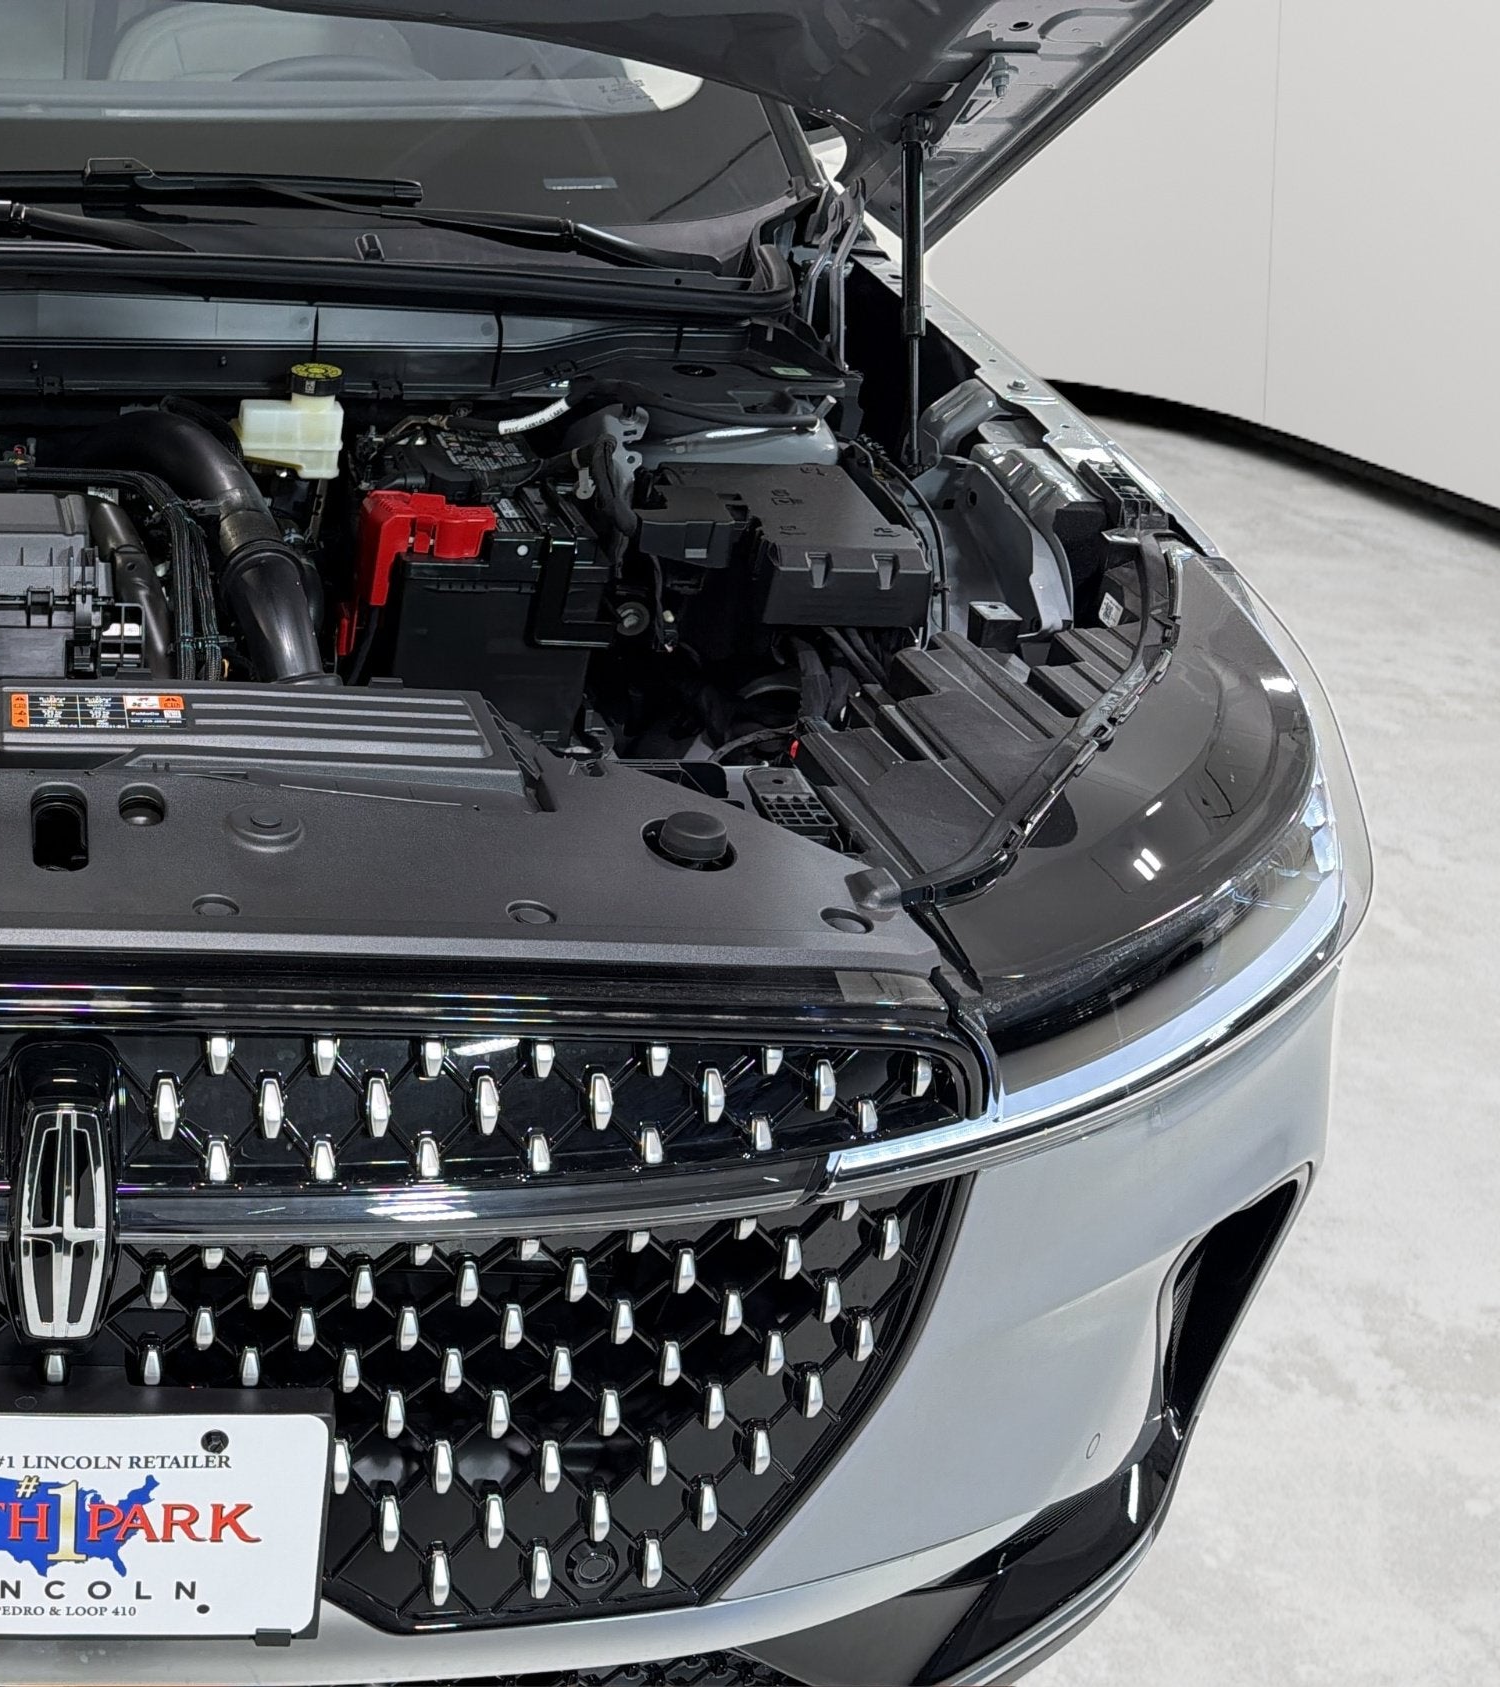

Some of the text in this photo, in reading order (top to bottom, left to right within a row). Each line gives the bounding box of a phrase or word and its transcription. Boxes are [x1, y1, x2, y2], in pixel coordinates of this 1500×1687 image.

[22, 1455, 122, 1470] LINCOLN
[128, 1455, 232, 1469] RETAILER
[88, 1503, 262, 1543] PARK
[48, 1605, 62, 1616] &
[65, 1606, 108, 1617] LOOP
[111, 1606, 137, 1617] 410
